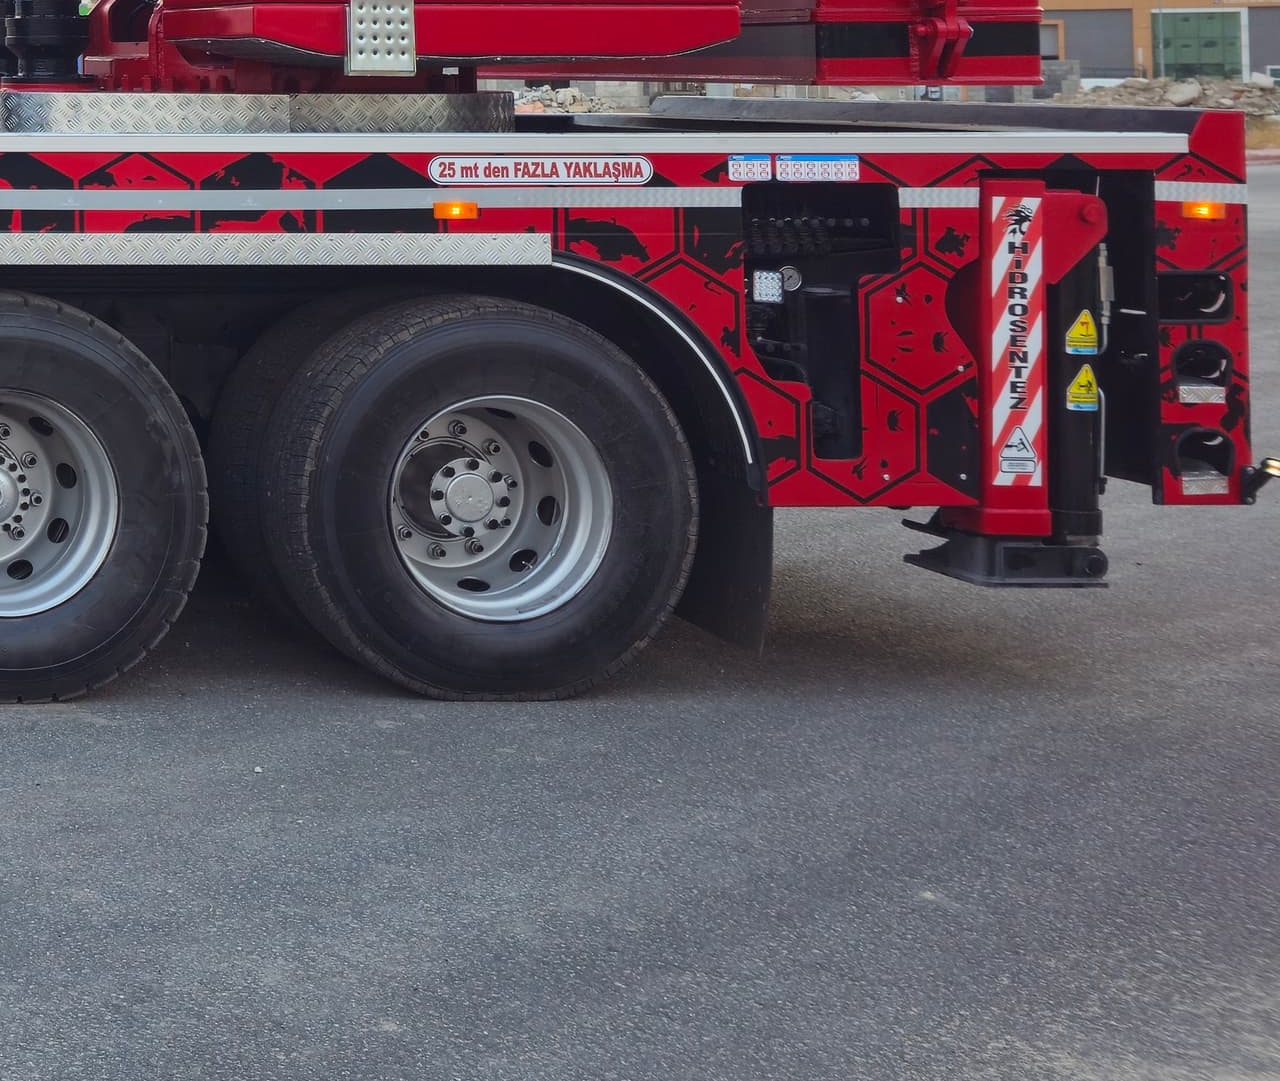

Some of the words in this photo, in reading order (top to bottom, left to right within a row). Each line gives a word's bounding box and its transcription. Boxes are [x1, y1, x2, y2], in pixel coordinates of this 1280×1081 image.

[438, 161, 456, 178] 25
[460, 163, 479, 178] mt
[483, 161, 509, 178] den
[513, 161, 560, 178] FAZLA
[563, 161, 644, 183] YAKLAŞMA
